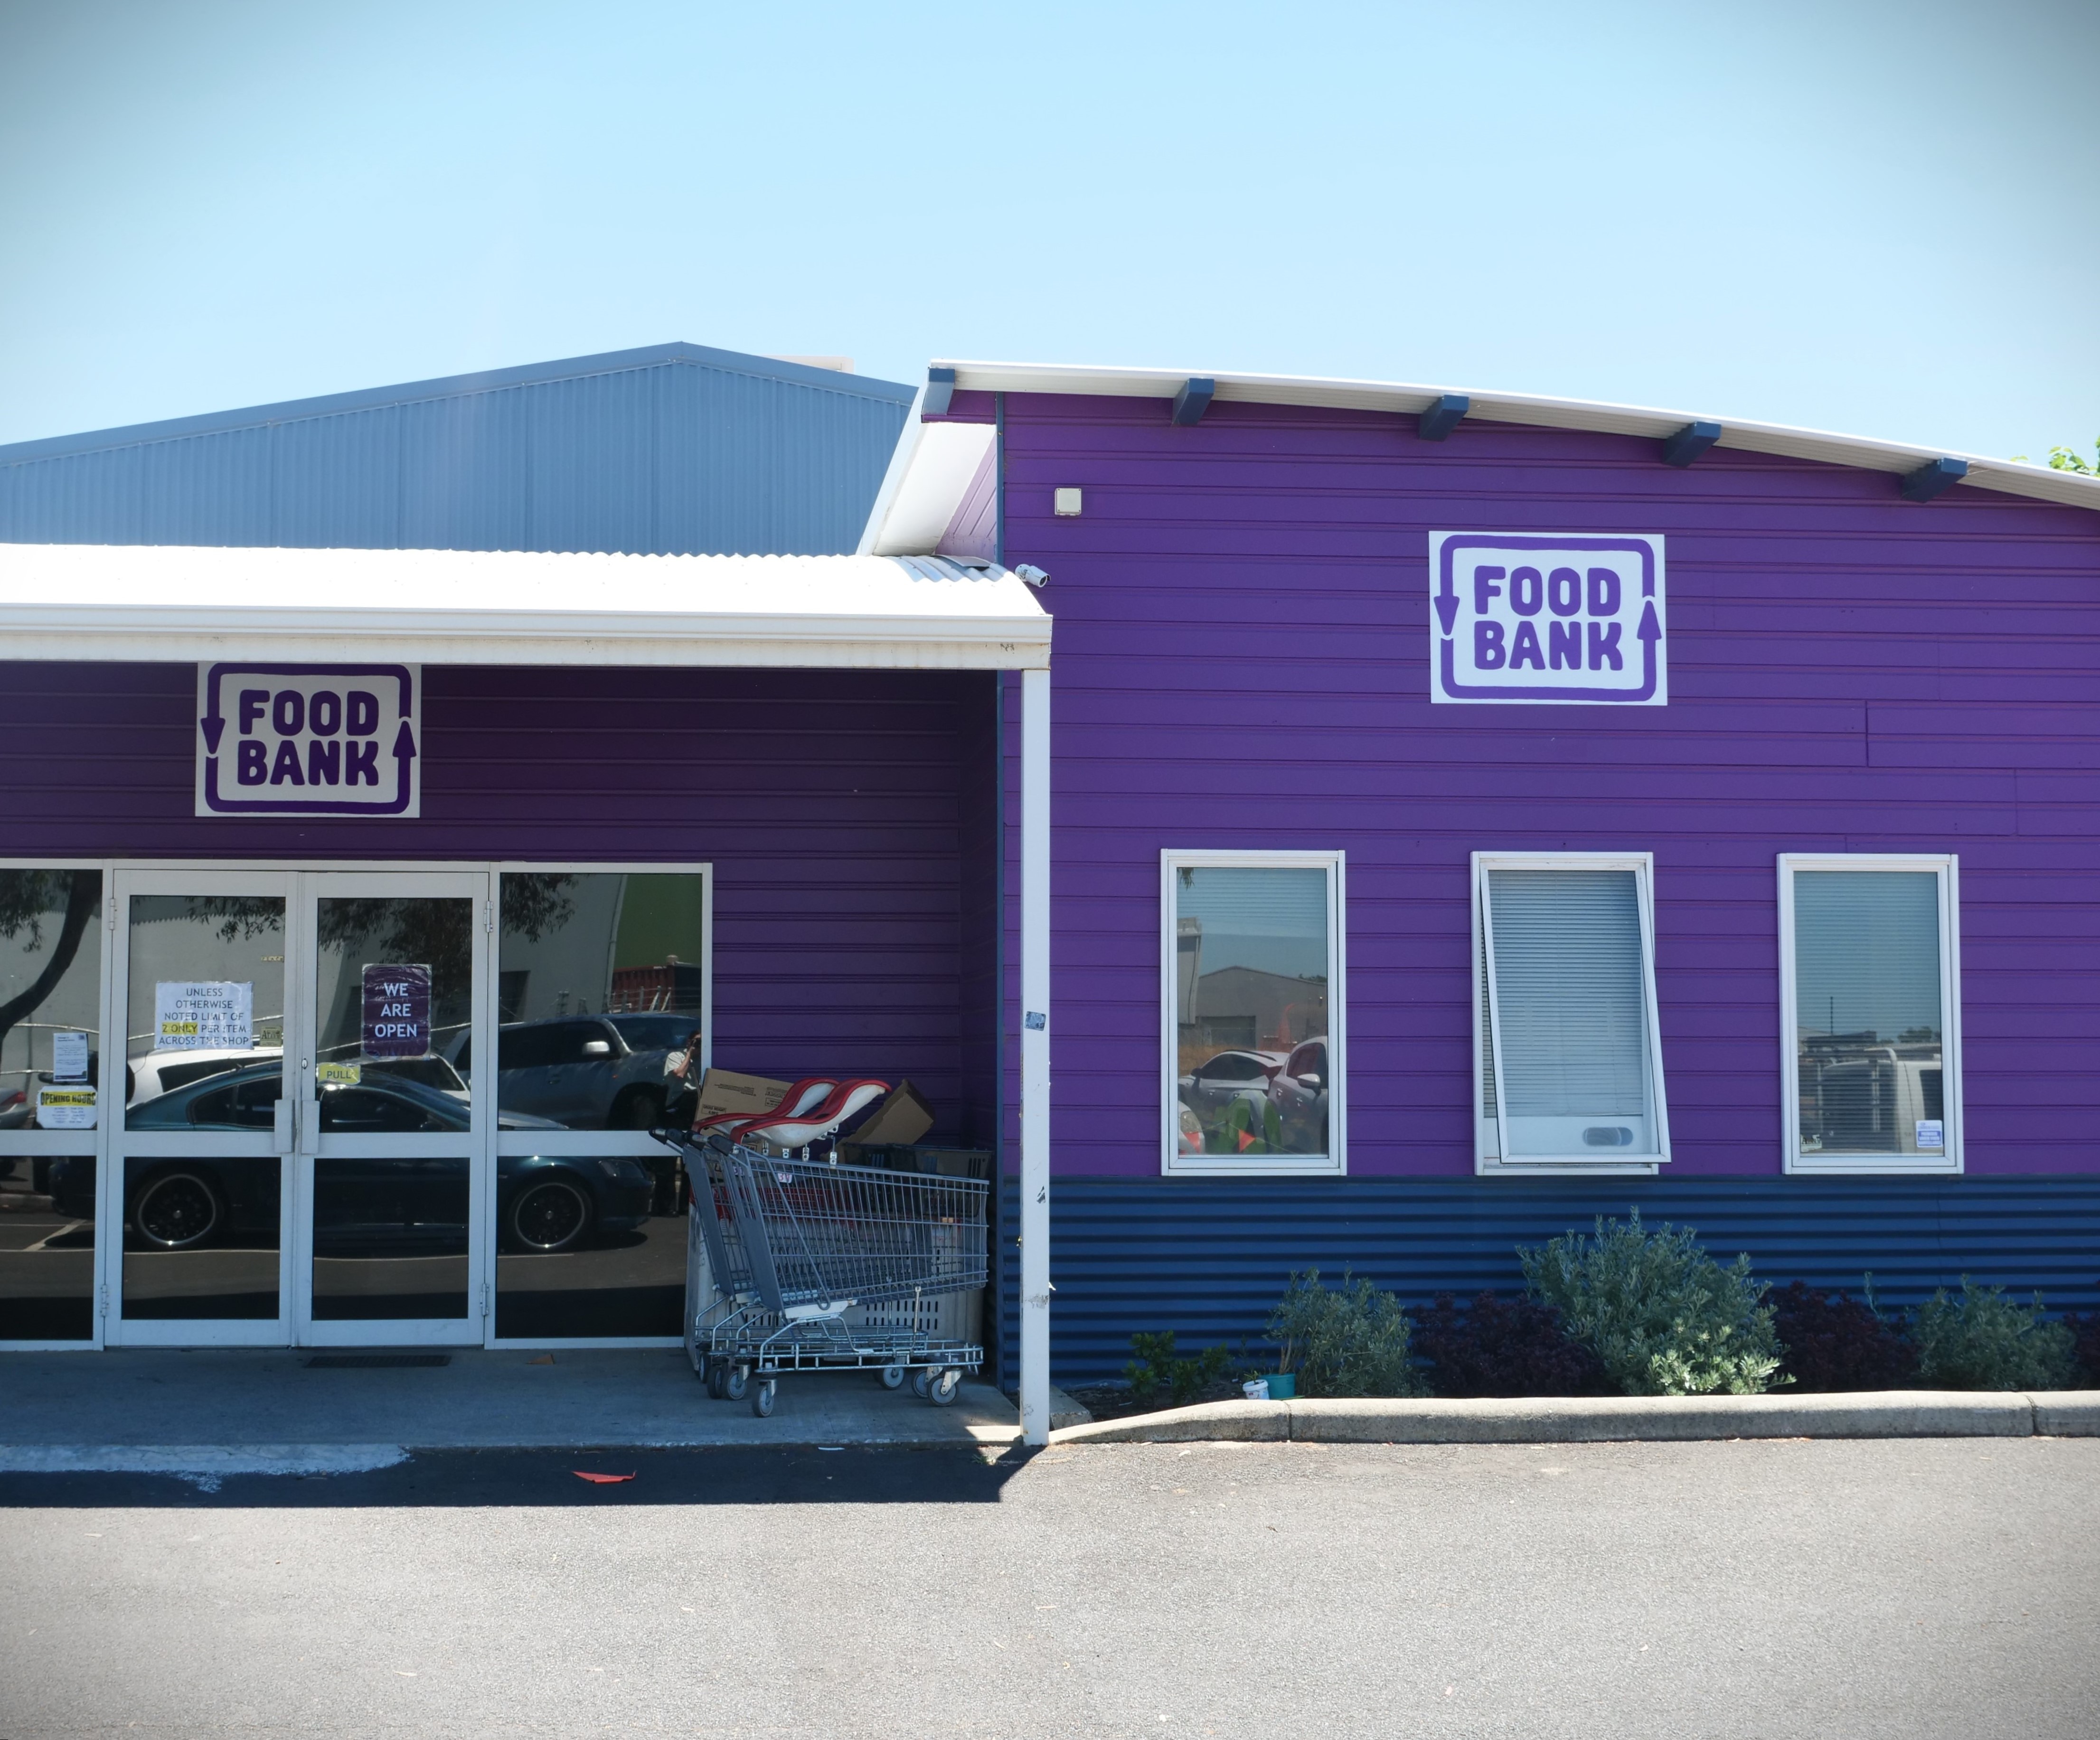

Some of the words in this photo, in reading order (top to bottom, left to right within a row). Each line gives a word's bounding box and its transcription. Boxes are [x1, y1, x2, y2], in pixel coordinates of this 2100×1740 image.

[1474, 565, 1621, 617] FOOD
[1474, 620, 1623, 671] BANK
[239, 689, 379, 736] FOOD
[237, 740, 379, 786] BANK
[186, 988, 223, 997] UNLESS
[384, 983, 408, 996] WE
[176, 1000, 233, 1008] OTHERWISE
[380, 1004, 412, 1017] ARE
[164, 1012, 198, 1021] NOTED
[201, 1013, 227, 1021] LIMIT
[230, 1013, 244, 1021] OF
[162, 1025, 168, 1033] 2
[171, 1025, 198, 1033] ONLY
[201, 1025, 219, 1033] PER
[223, 1025, 246, 1033] ITEM
[375, 1024, 417, 1037] OPEN
[159, 1036, 197, 1045] ACROSS
[200, 1036, 219, 1045] THE
[222, 1036, 249, 1045] SHOP
[326, 1071, 352, 1079] PULL
[40, 1092, 71, 1106] OPENING
[72, 1092, 96, 1106] HOURS
